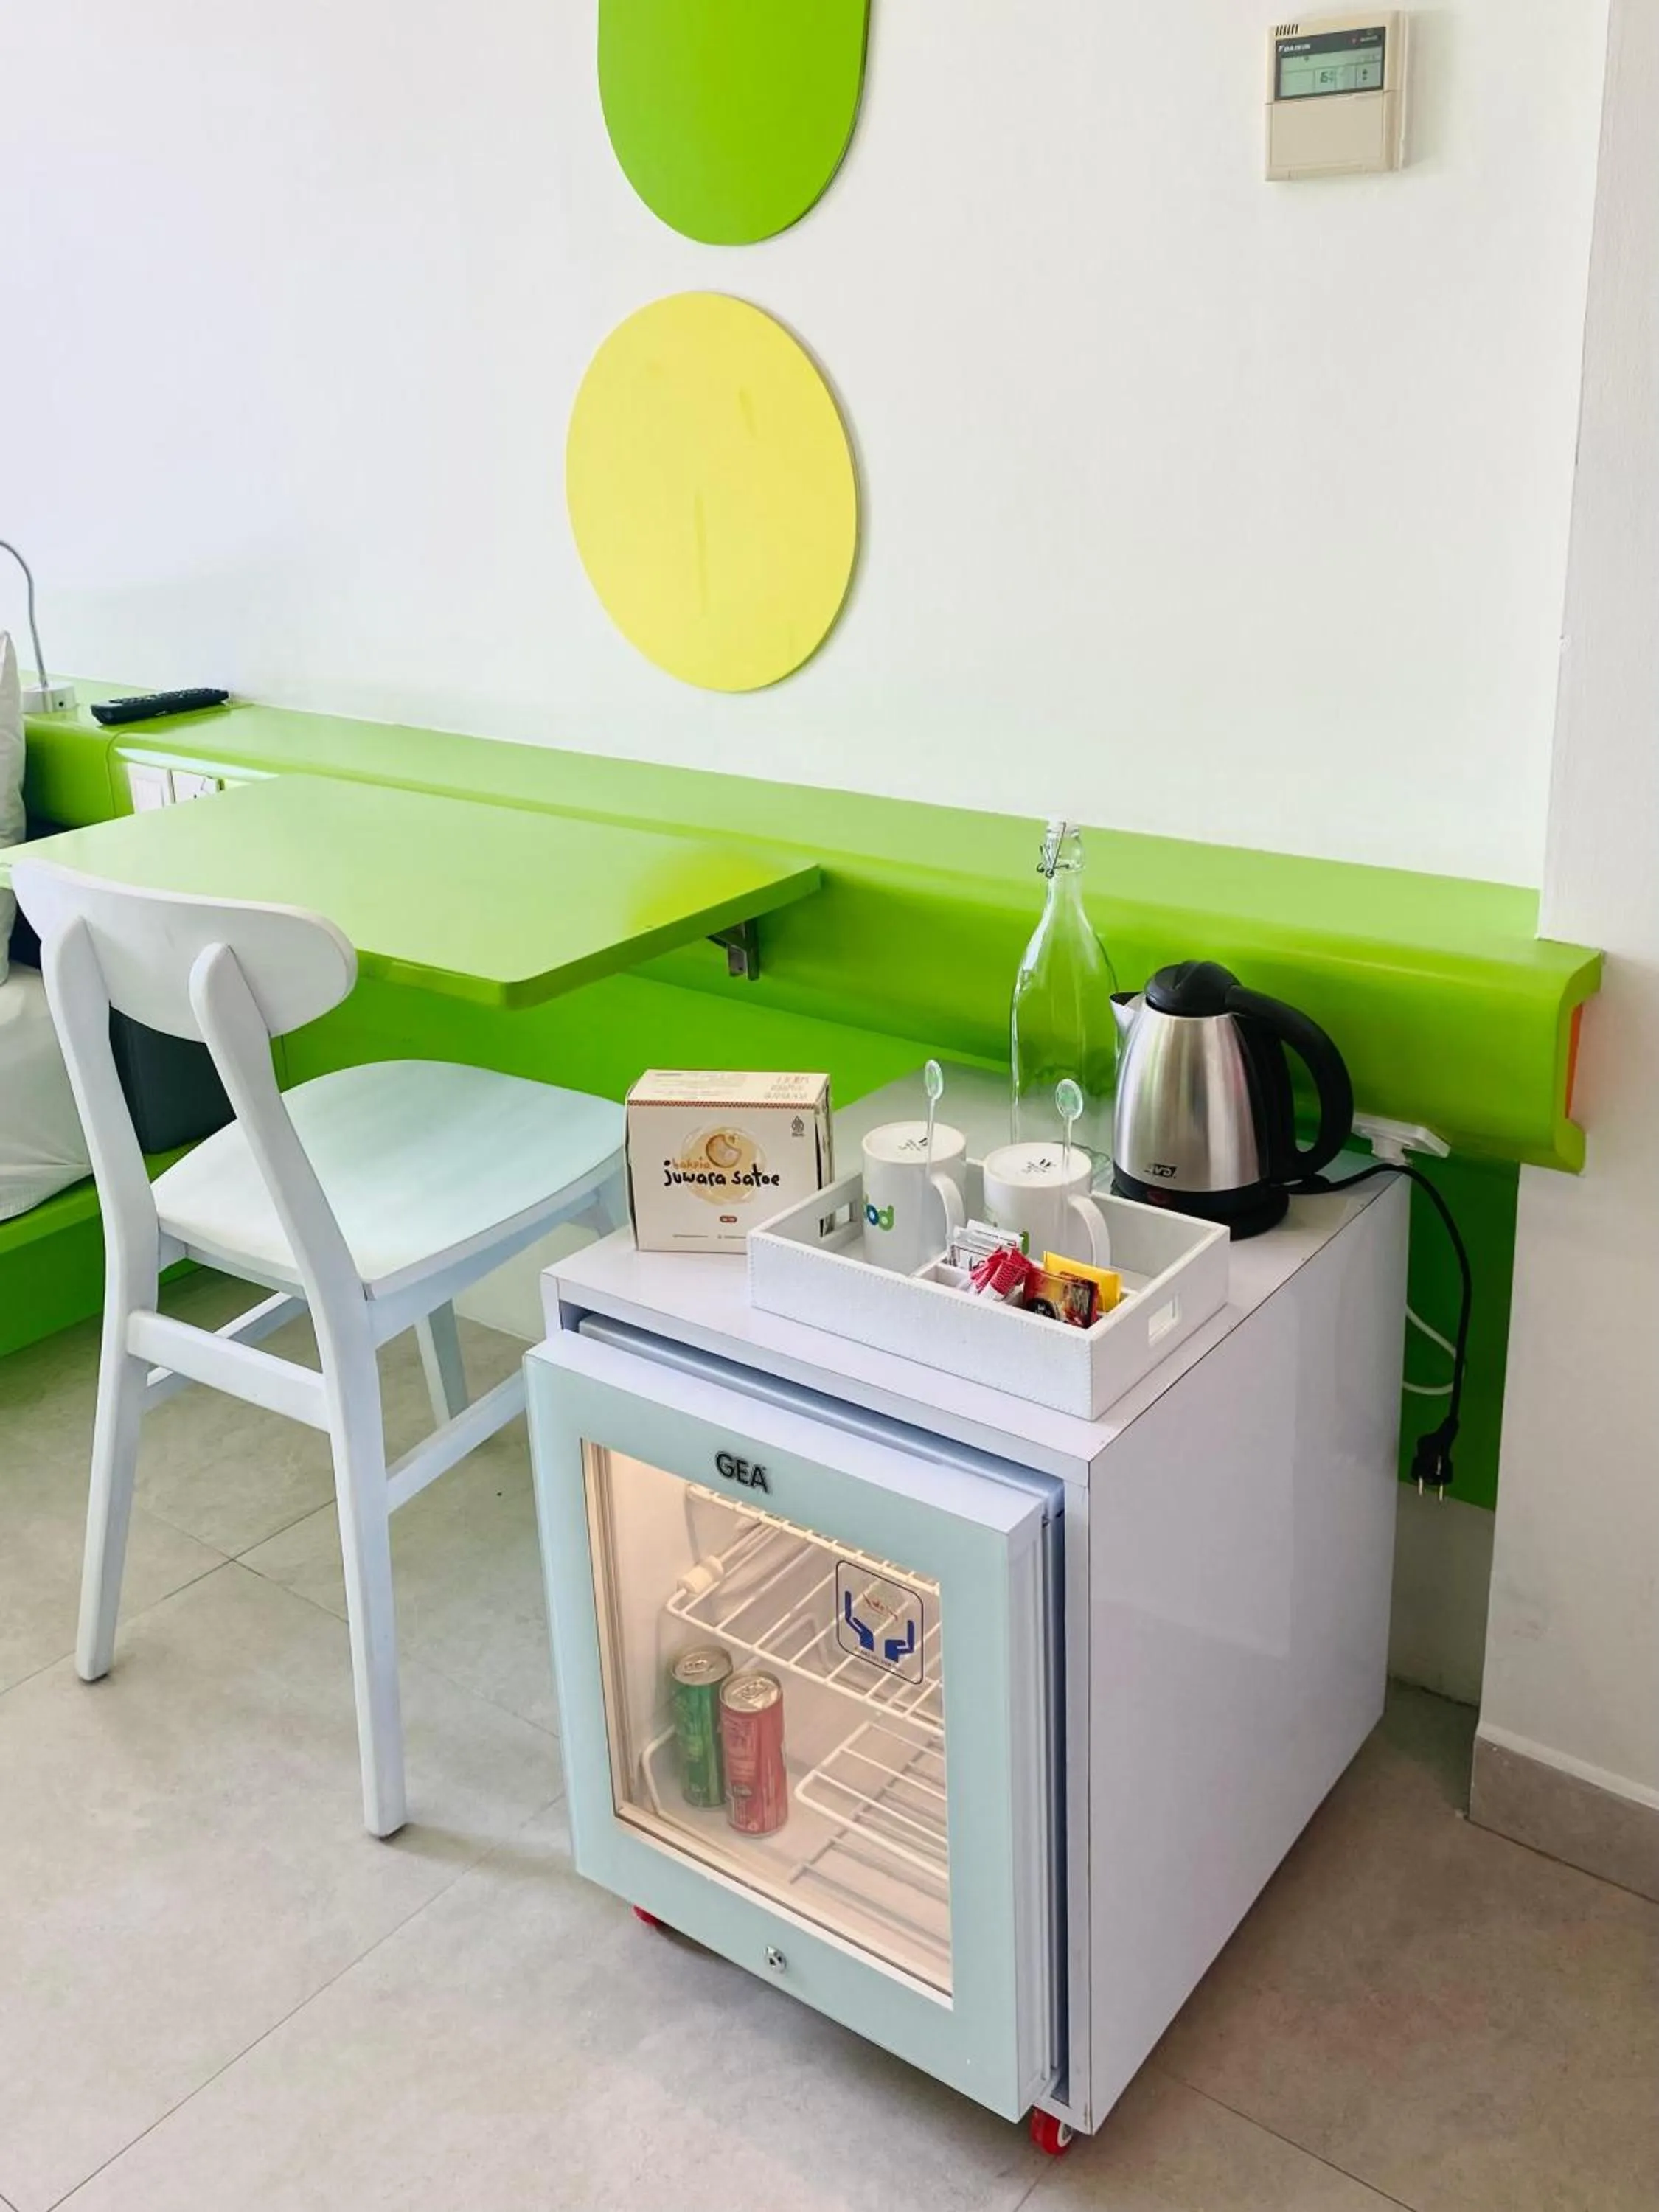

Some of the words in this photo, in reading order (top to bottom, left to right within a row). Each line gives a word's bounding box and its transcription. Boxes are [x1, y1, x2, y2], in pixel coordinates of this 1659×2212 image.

[664, 1160, 726, 1186] juwara
[731, 1163, 780, 1187] satoe
[715, 1452, 769, 1495] GEA
